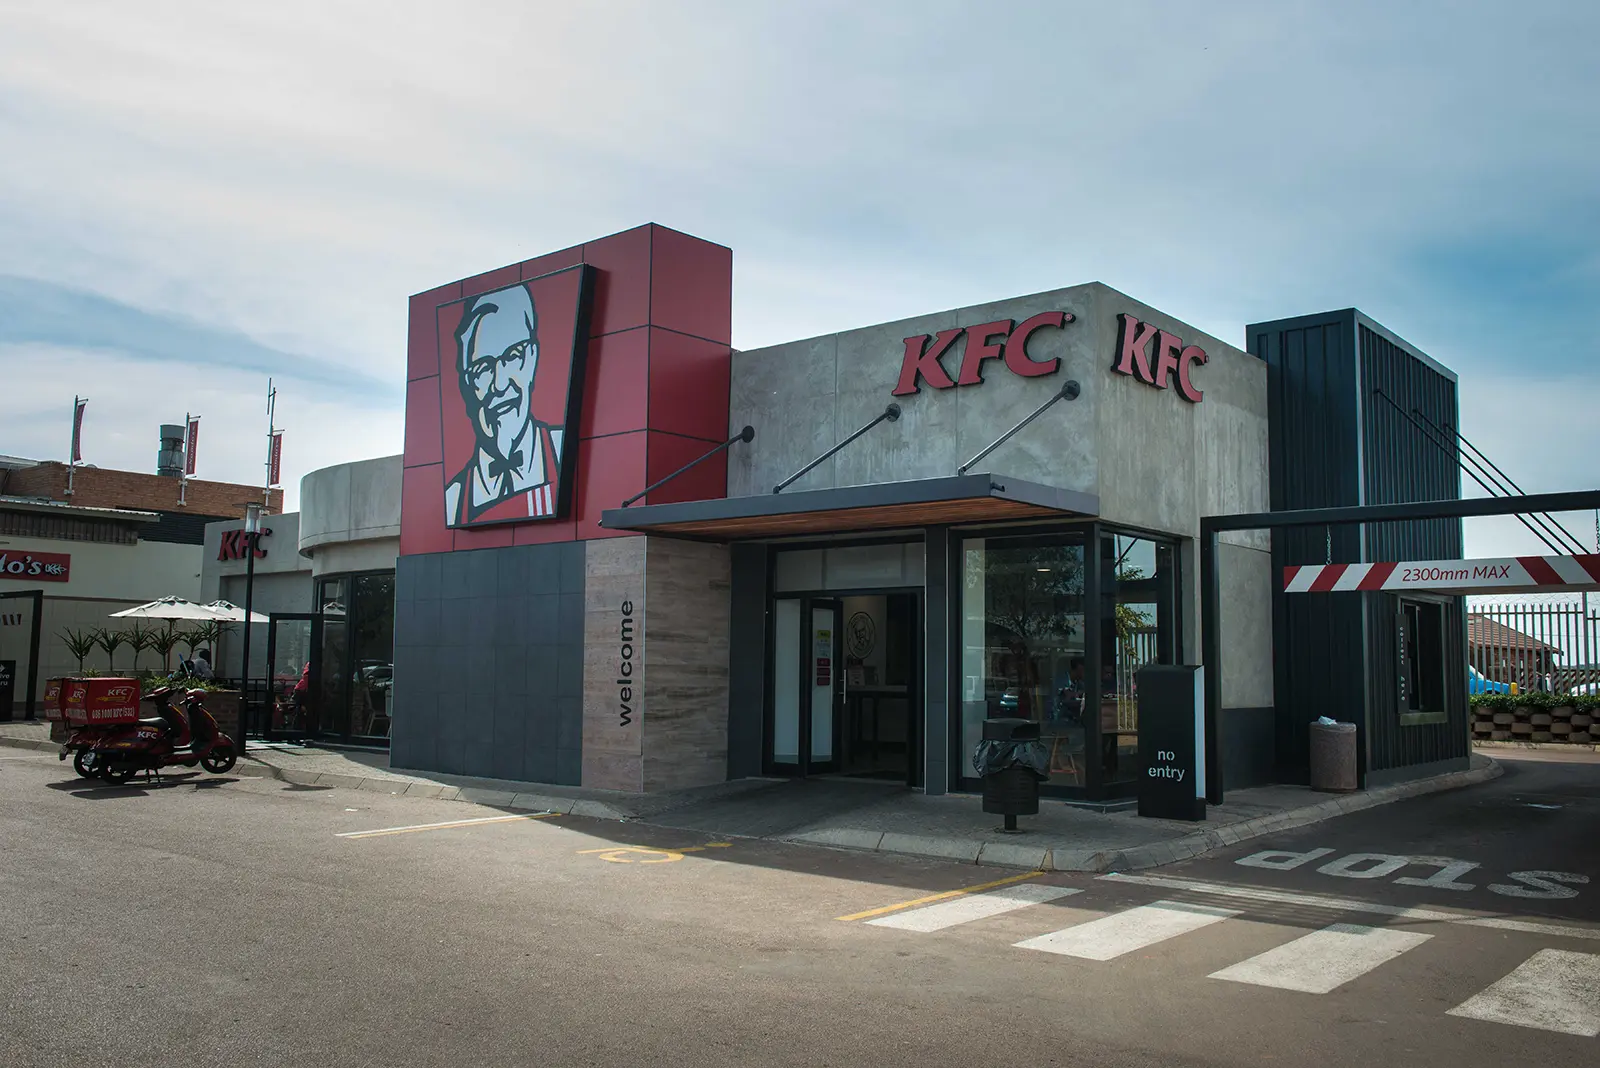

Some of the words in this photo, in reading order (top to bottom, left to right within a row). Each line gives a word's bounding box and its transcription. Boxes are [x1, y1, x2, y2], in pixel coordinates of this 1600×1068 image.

[891, 311, 1064, 396] KFC
[1111, 313, 1206, 403] KFC
[1402, 567, 1469, 582] 2300mm
[1473, 565, 1511, 579] MAX
[617, 600, 633, 727] welcome
[107, 688, 128, 696] KFC
[137, 731, 157, 739] KFC
[1157, 750, 1175, 761] no
[1148, 765, 1185, 782] entry
[1234, 847, 1590, 899] STOP
